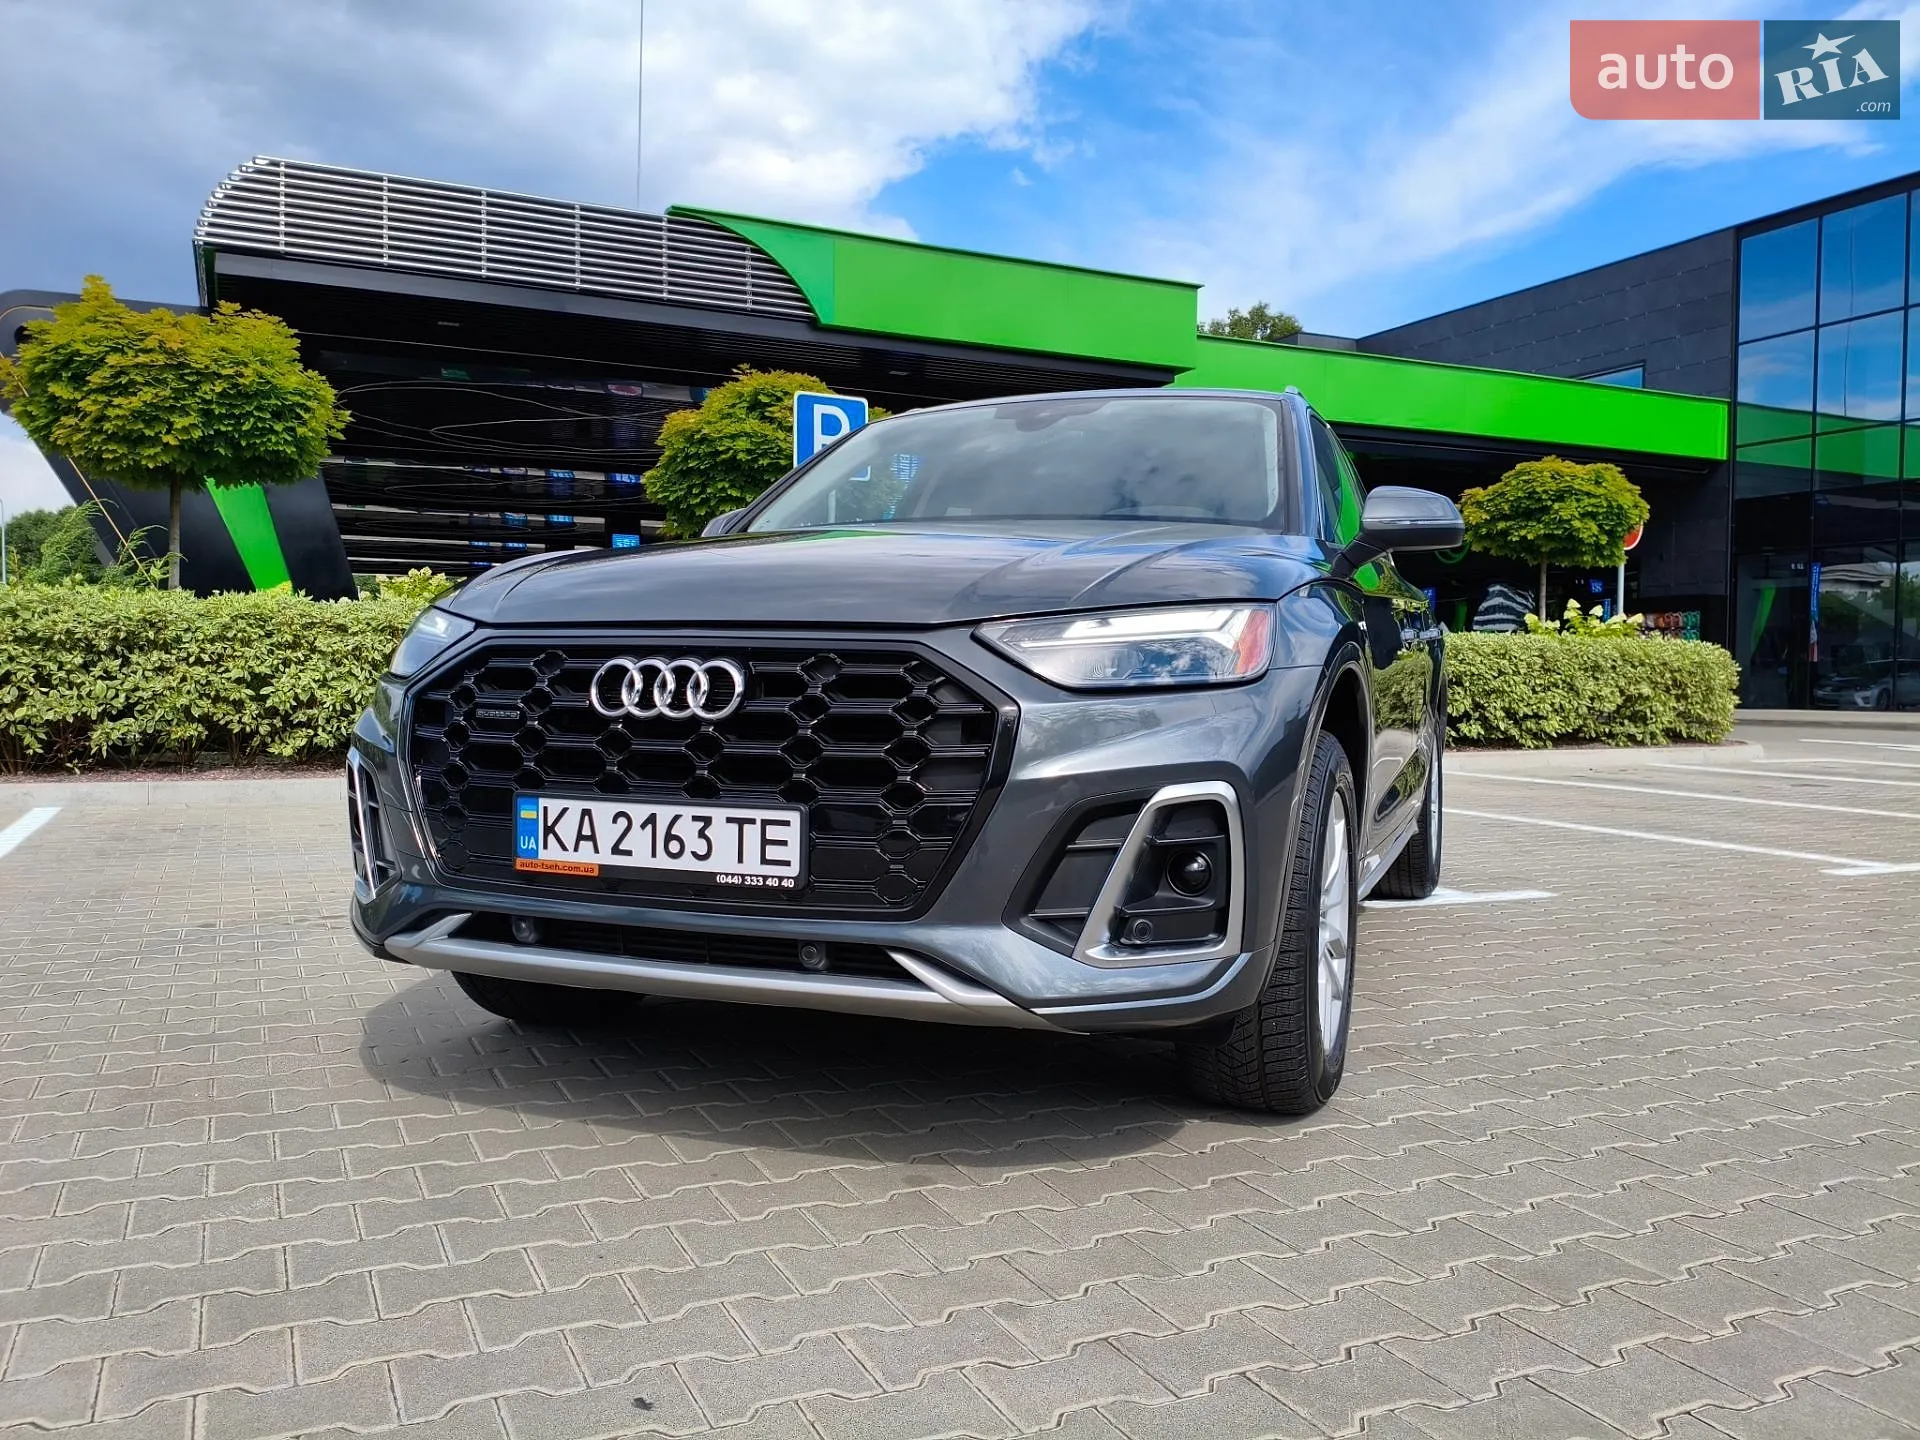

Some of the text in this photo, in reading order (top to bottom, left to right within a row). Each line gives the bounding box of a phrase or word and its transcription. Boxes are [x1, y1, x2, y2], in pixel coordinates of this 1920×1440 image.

[813, 403, 851, 455] P
[520, 836, 537, 850] UA
[542, 805, 791, 867] KA 2163 TE
[520, 861, 595, 874] auto-tseh.com.ua
[716, 874, 795, 888] (044) 333 40 40
